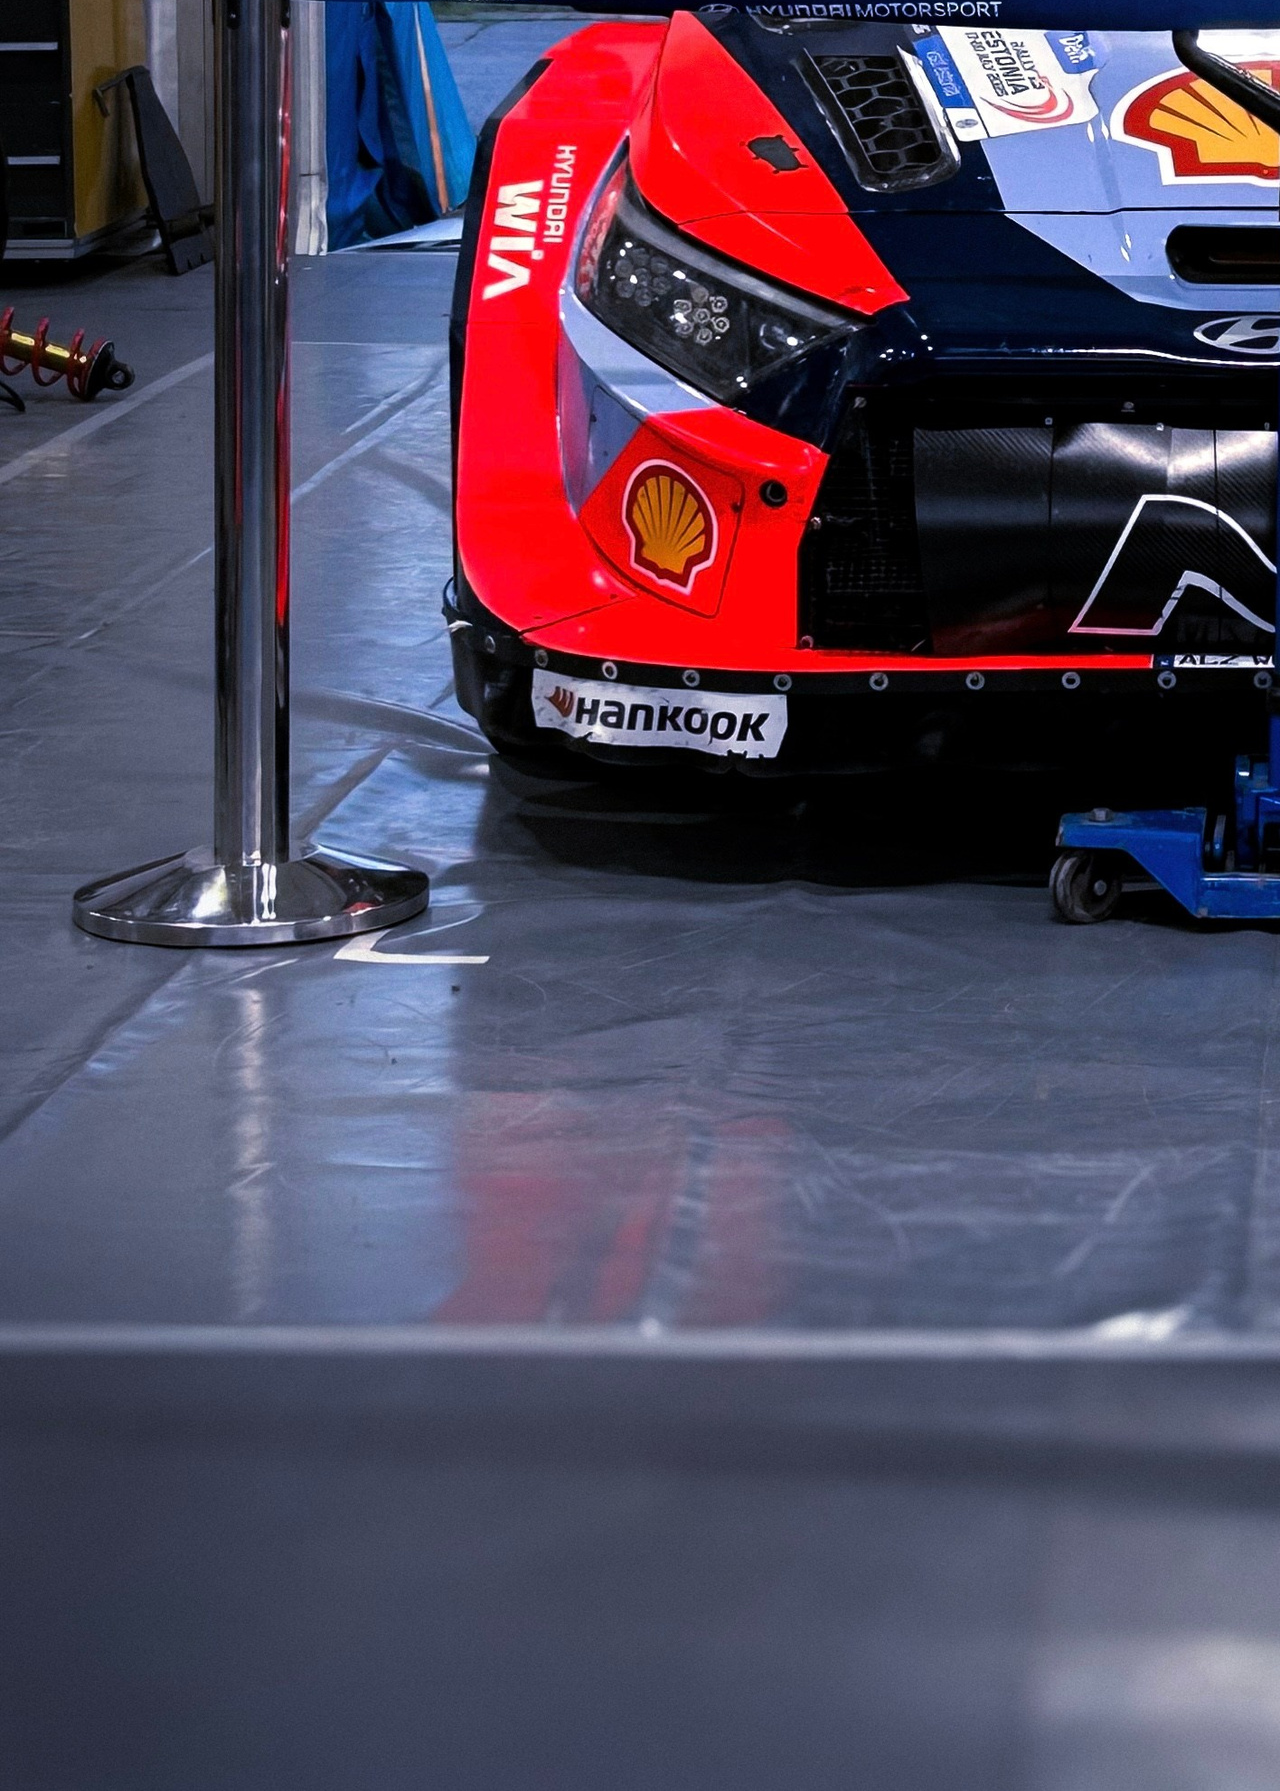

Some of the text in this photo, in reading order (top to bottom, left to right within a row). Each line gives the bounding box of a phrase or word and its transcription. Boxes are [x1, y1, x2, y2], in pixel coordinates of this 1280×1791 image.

[856, 1, 1002, 18] MOTORSPORT
[981, 30, 1030, 96] ESTONIA
[542, 145, 577, 243] HYUNDAI
